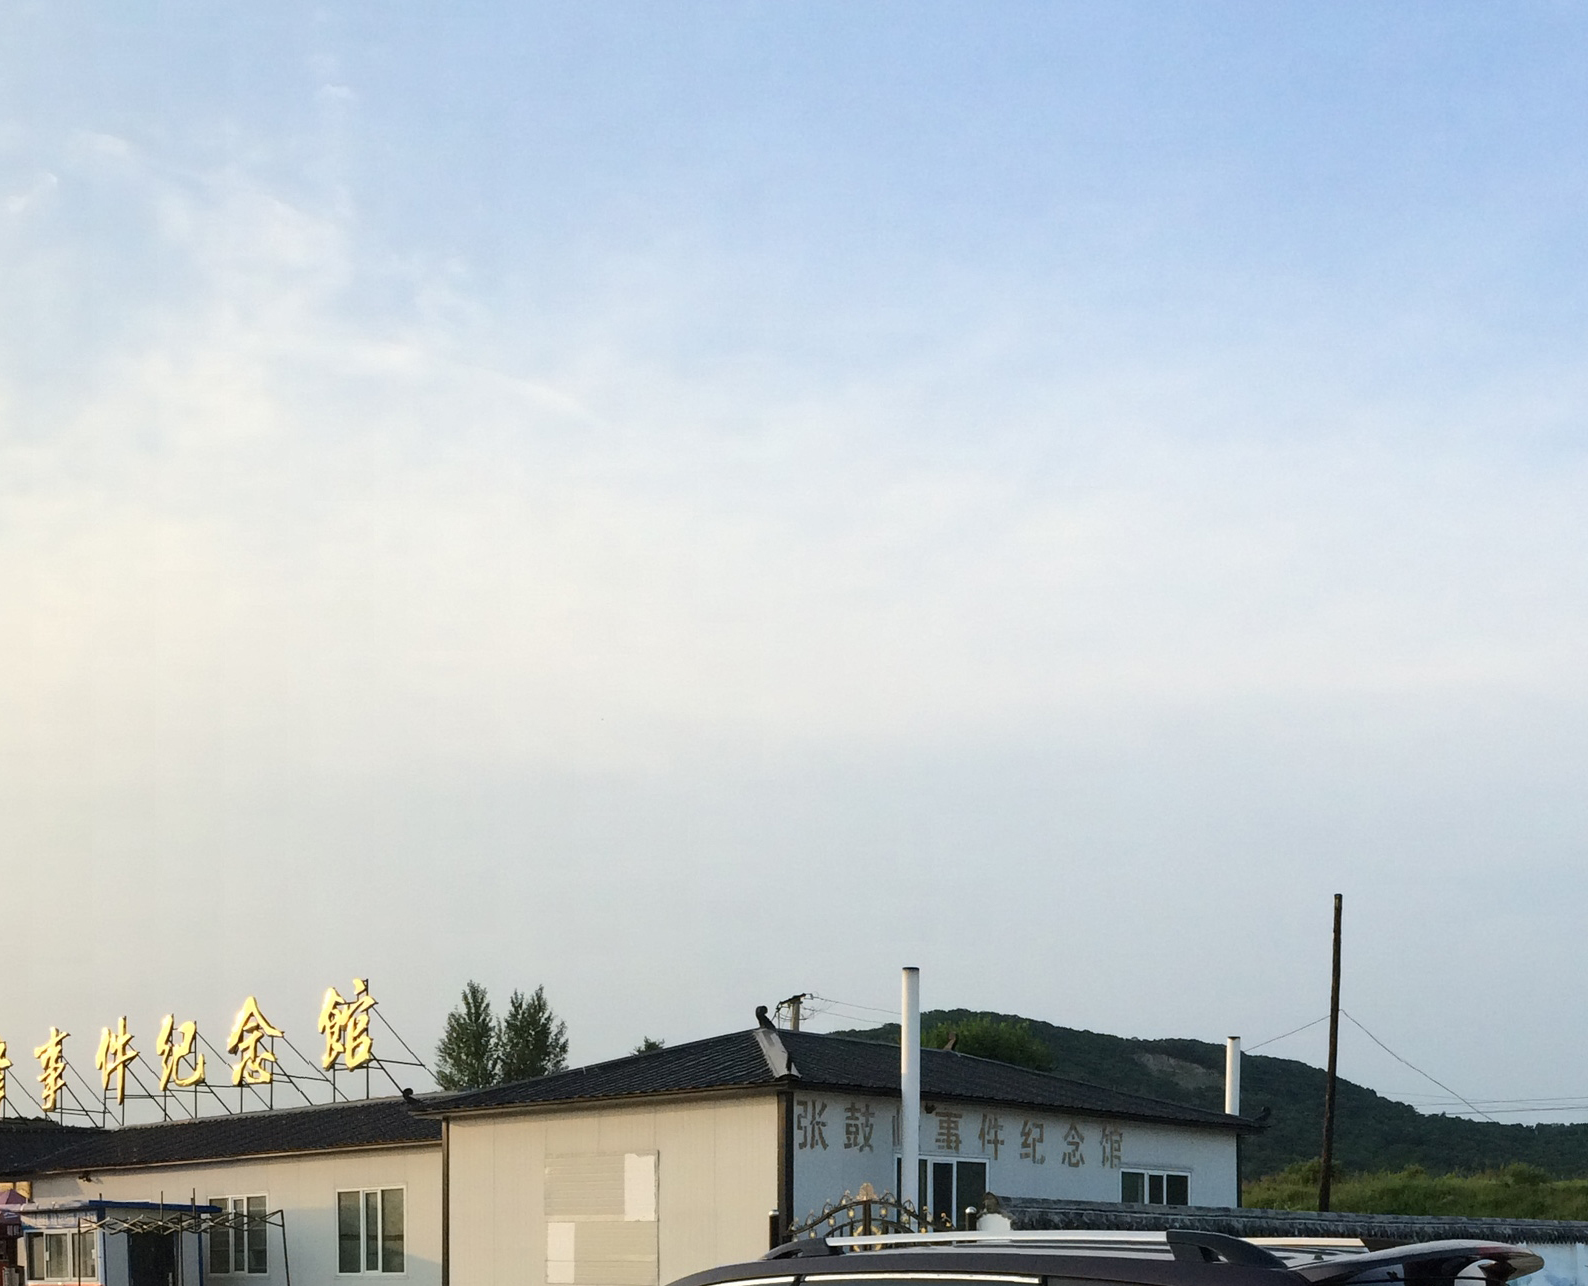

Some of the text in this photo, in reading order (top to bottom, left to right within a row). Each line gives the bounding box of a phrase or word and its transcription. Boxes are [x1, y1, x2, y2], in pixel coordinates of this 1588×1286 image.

[796, 1100, 1124, 1169] 张鼓事件纪念馆
